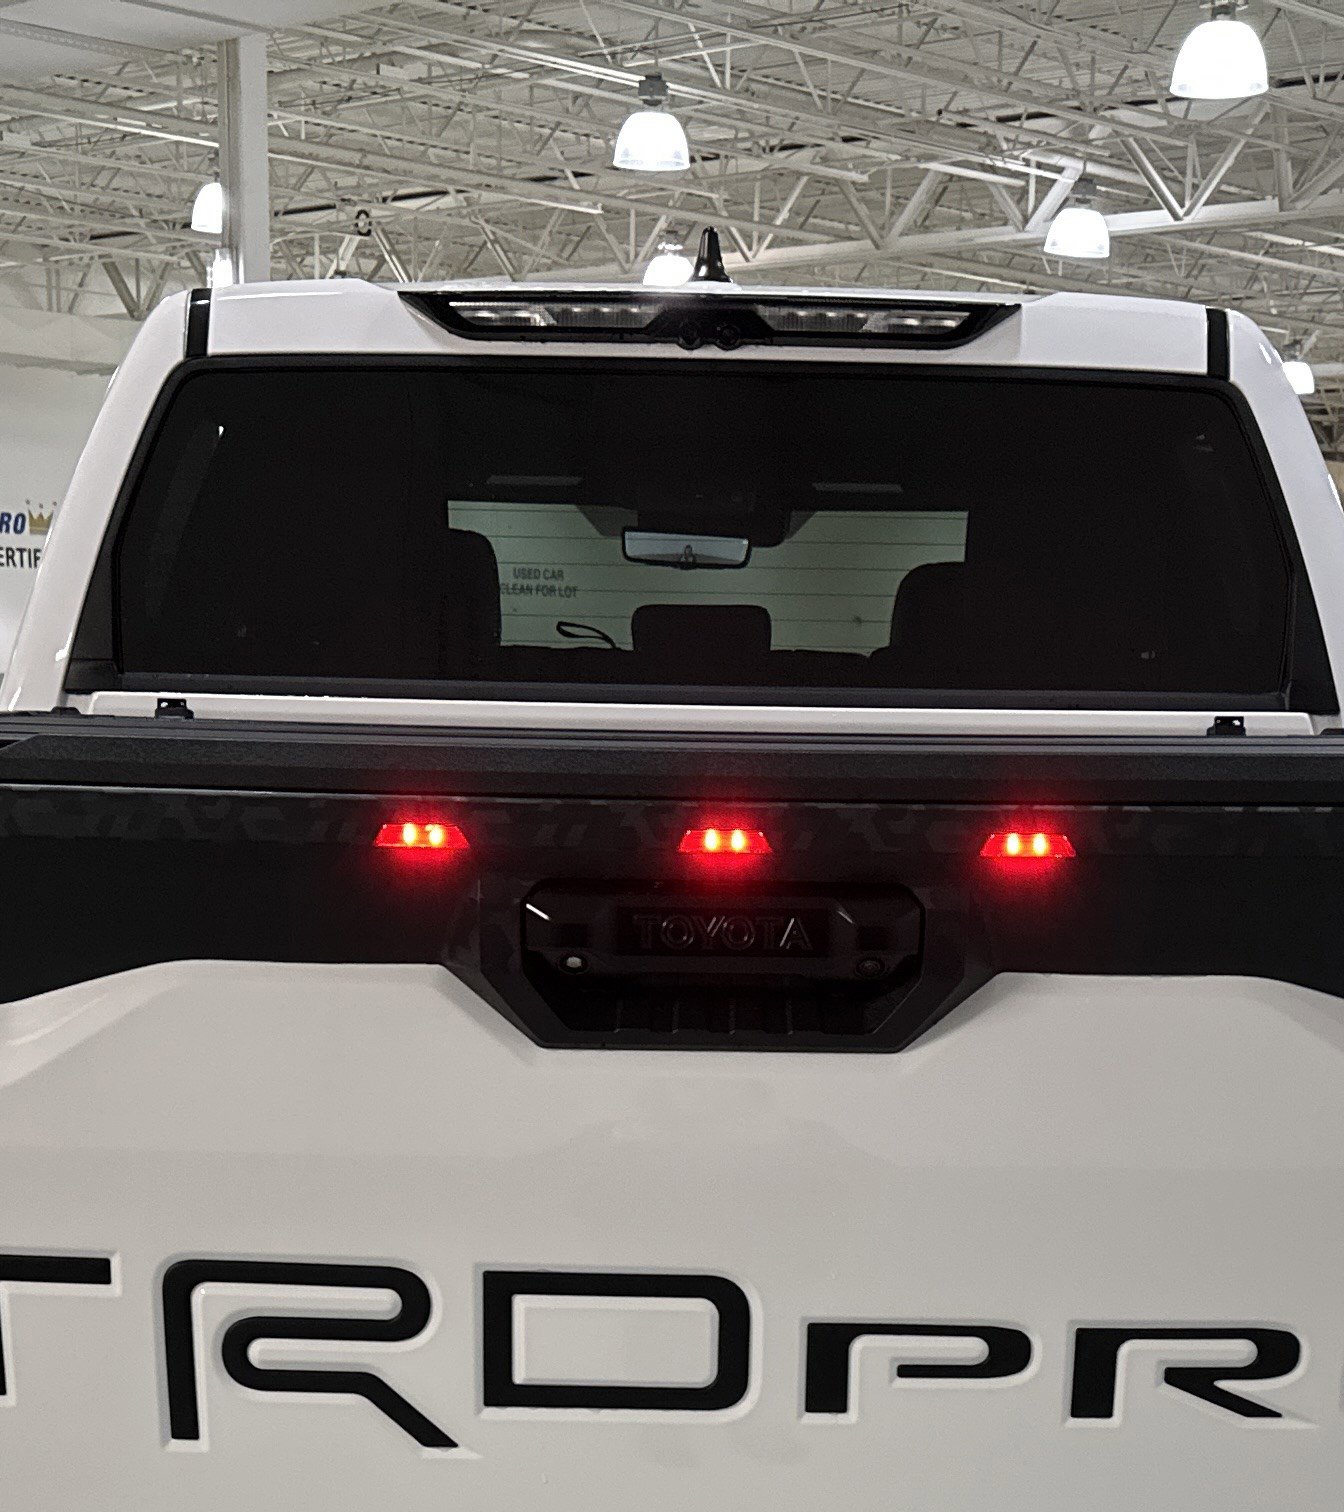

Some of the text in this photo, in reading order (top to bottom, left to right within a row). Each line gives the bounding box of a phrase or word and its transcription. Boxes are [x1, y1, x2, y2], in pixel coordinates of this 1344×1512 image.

[512, 567, 564, 582] USED CAR
[536, 583, 556, 598] FOR
[558, 584, 578, 598] LOT
[633, 914, 813, 951] TOYOTA
